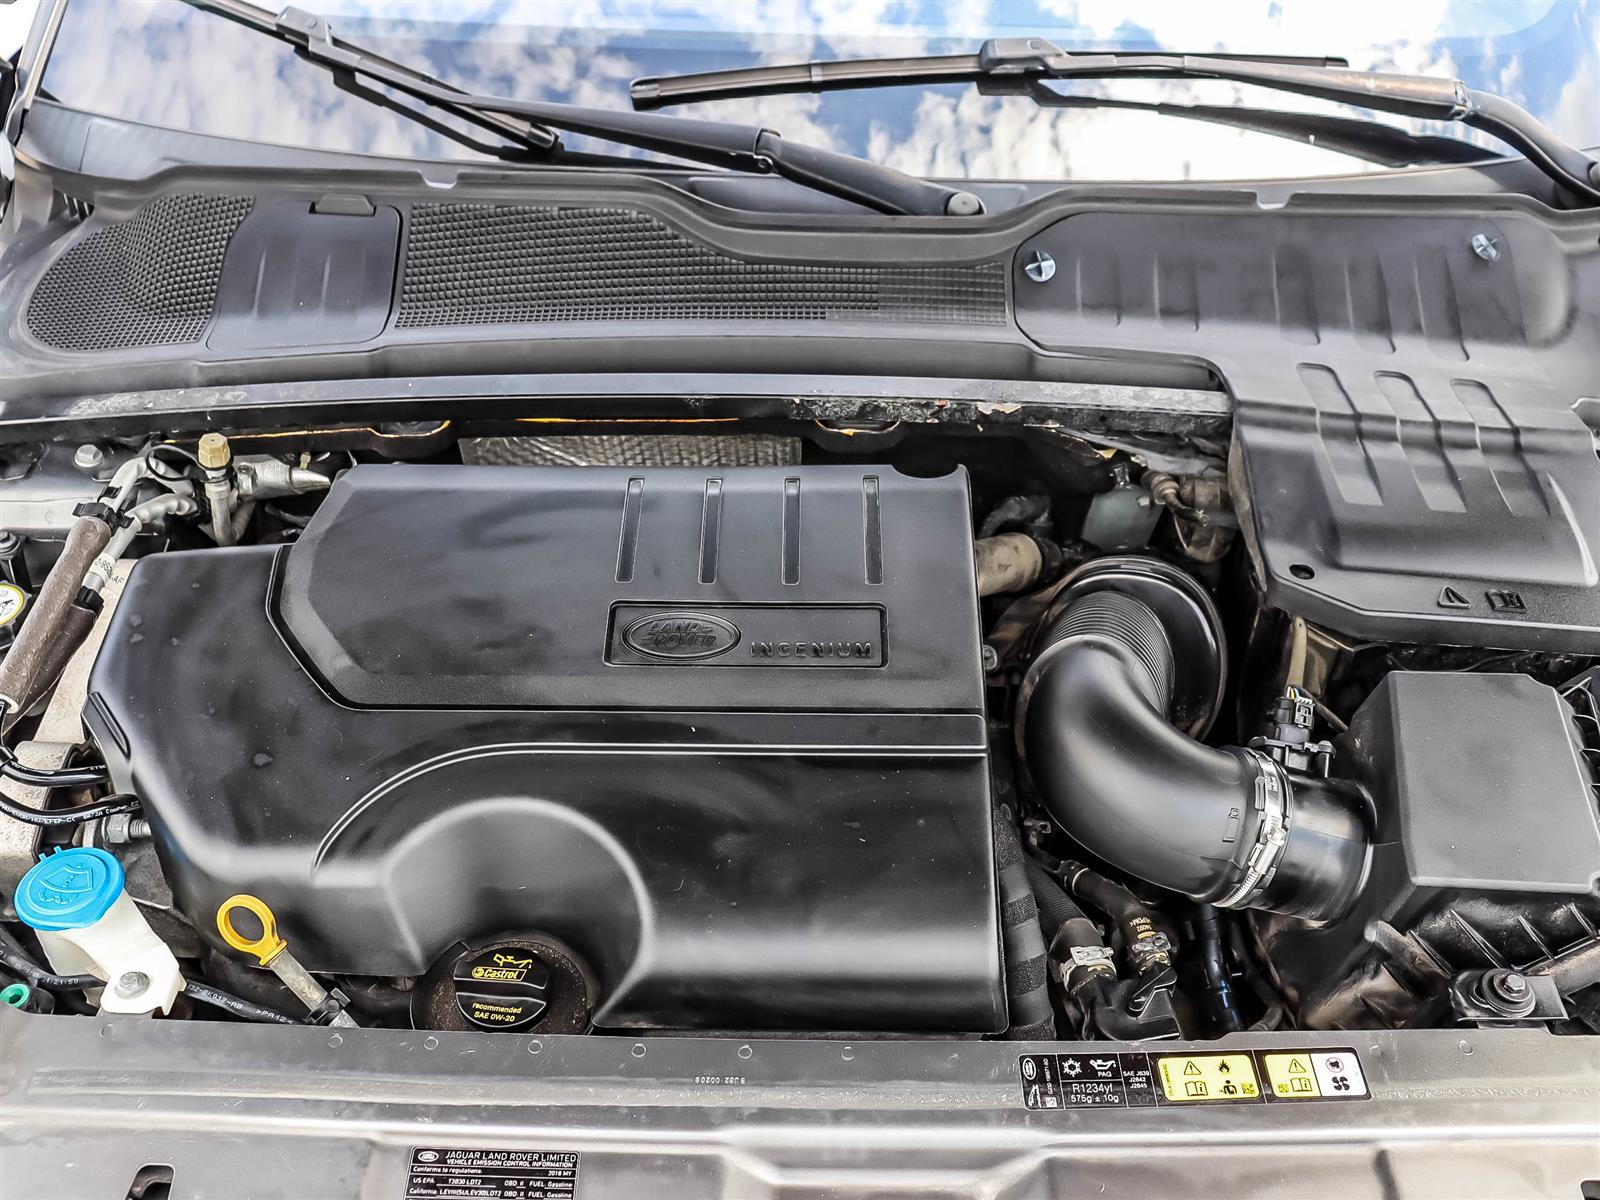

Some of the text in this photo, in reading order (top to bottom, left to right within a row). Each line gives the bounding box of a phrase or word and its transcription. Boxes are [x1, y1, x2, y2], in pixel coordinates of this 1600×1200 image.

[649, 620, 699, 633] LAND
[653, 632, 717, 648] ROVER
[750, 641, 873, 659] INGENIUM
[483, 968, 519, 979] Castrol
[472, 1002, 523, 1014] recommended
[473, 1011, 516, 1022] SAE 0W-20
[1072, 1083, 1113, 1094] R1234yf
[1070, 1094, 1093, 1103] 575g
[1103, 1094, 1119, 1103] 10g
[445, 1151, 480, 1159] JAGUAR
[482, 1152, 507, 1160] LAND
[509, 1153, 539, 1161] ROVER
[541, 1154, 577, 1162] LIMITED
[546, 1191, 572, 1199] Gasoline
